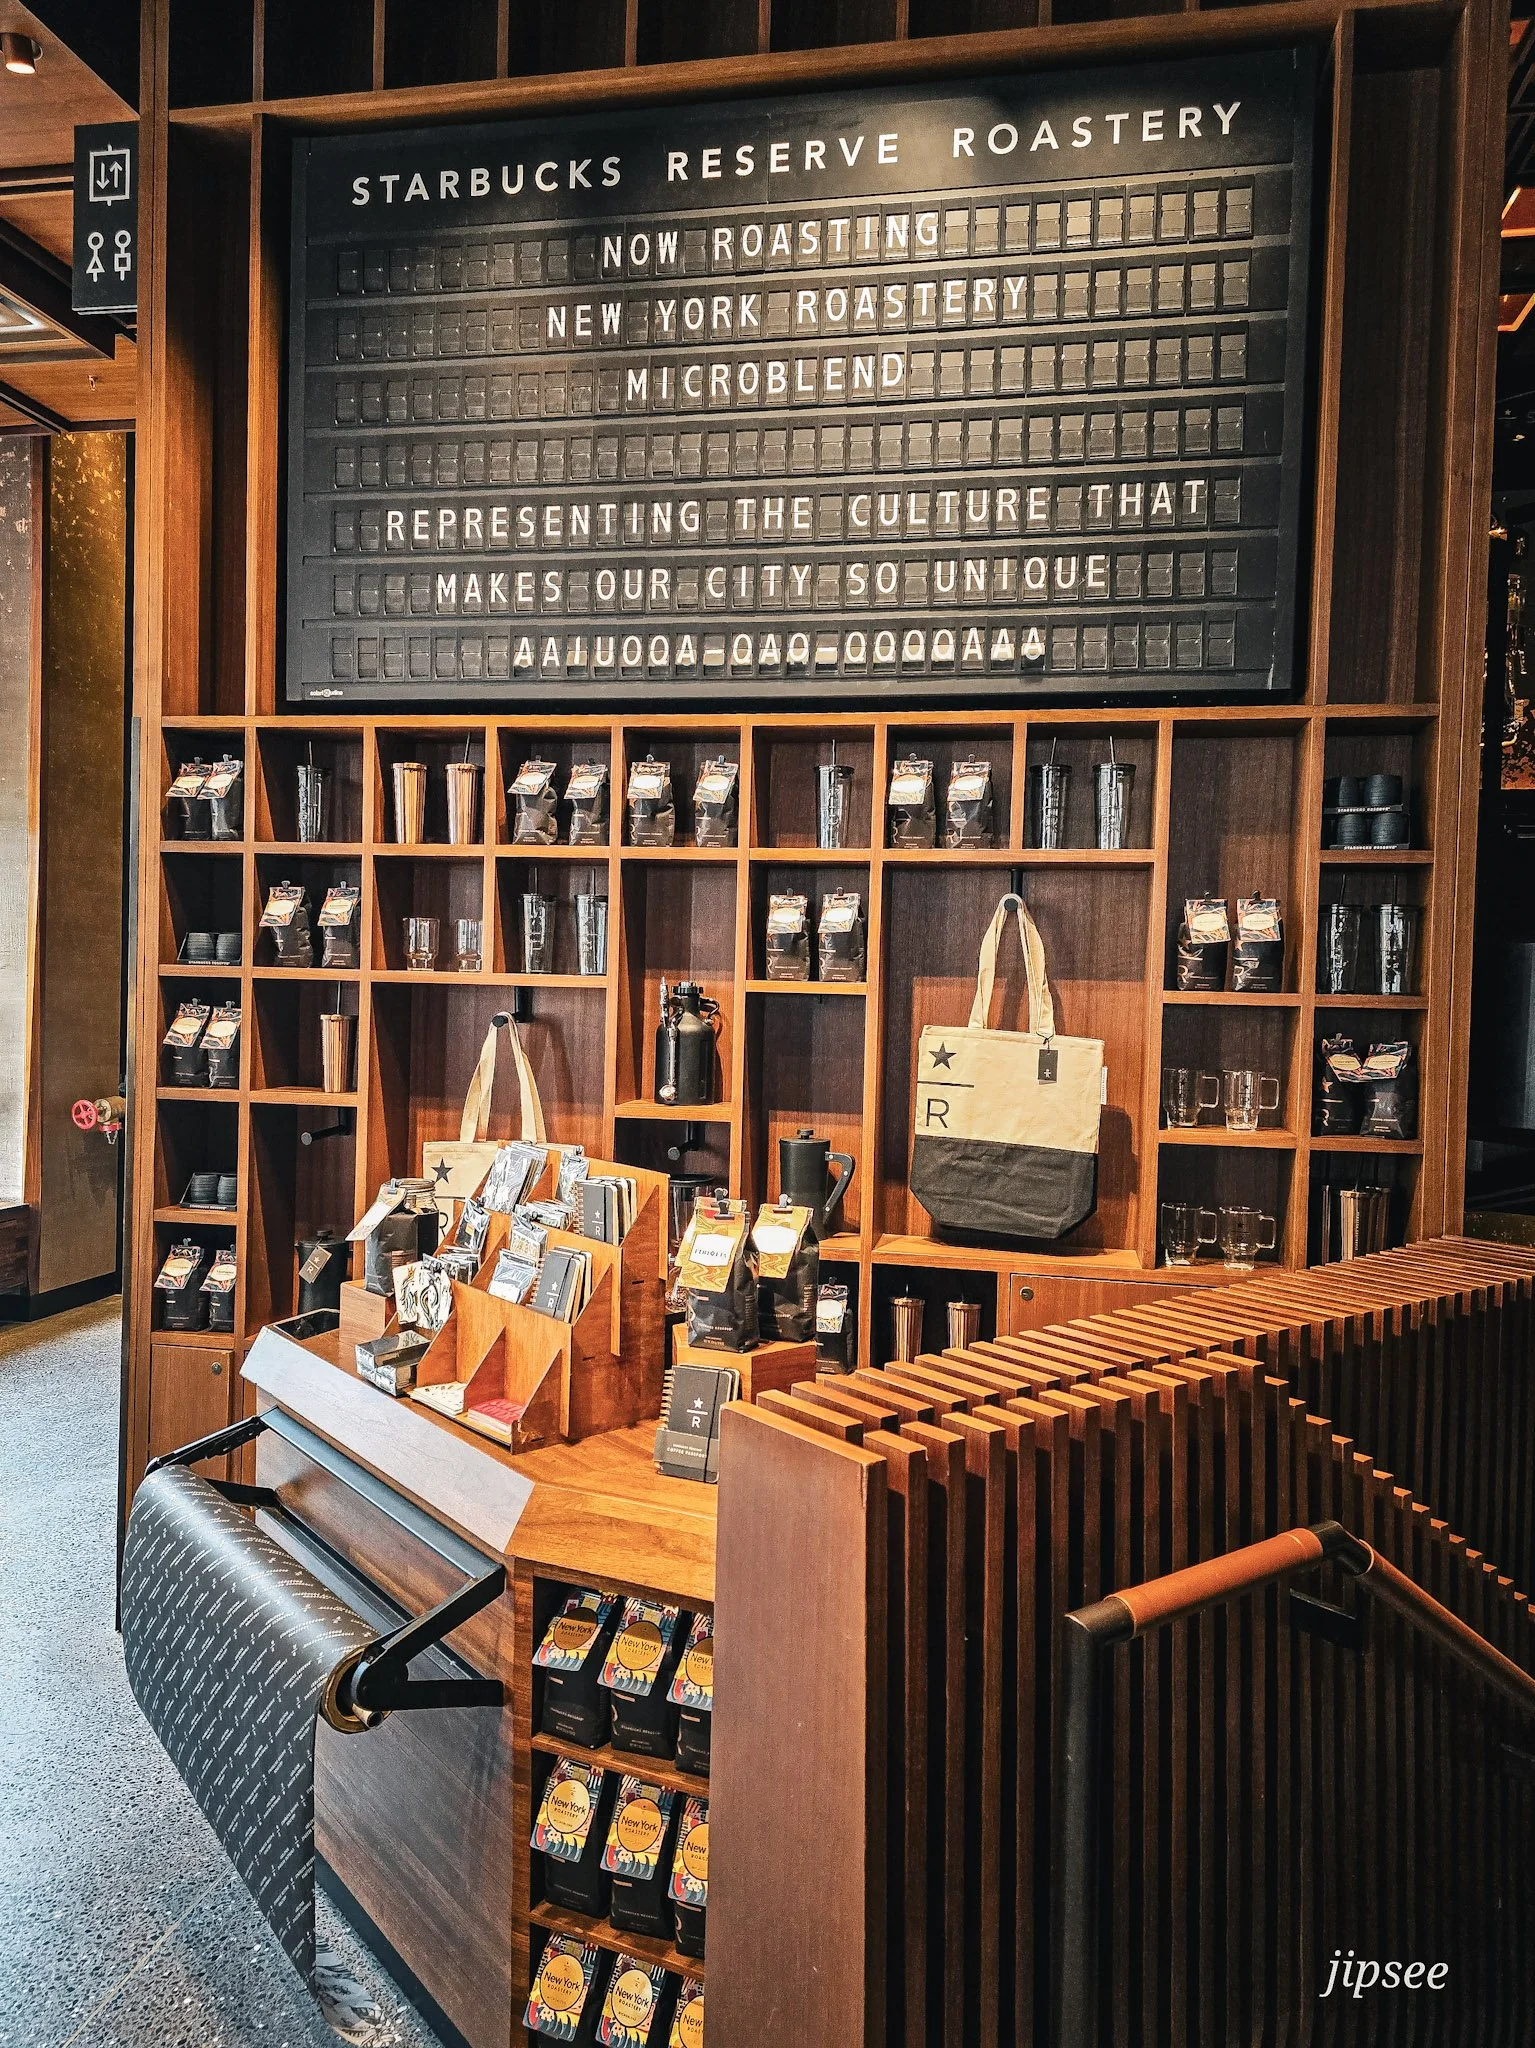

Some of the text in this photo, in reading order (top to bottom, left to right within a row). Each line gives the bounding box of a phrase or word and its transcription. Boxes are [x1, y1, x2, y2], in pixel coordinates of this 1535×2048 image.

[352, 101, 1241, 206] STARBUCKS RESERVE ROASTERY
[602, 211, 938, 268] NOW ROASTING
[547, 275, 1027, 338] NEW YORK ROASTERY
[627, 352, 904, 401] MICROBLEND
[385, 479, 1205, 541] REPRESENTING THE CULTURE THAT
[436, 553, 1107, 604] MAKES OUR CITY SO UNIQUE
[926, 1098, 950, 1129] R
[595, 1226, 601, 1236] R
[547, 1298, 554, 1309] R
[691, 1416, 701, 1429] R
[558, 1622, 593, 1635] New York
[620, 1636, 659, 1653] New York
[691, 1653, 710, 1666] New
[550, 1796, 587, 1816] New York
[620, 1815, 659, 1833] New York
[686, 1841, 707, 1854] New
[544, 1971, 581, 1992] New York
[615, 1985, 650, 2009] New York
[682, 2013, 703, 2027] New
